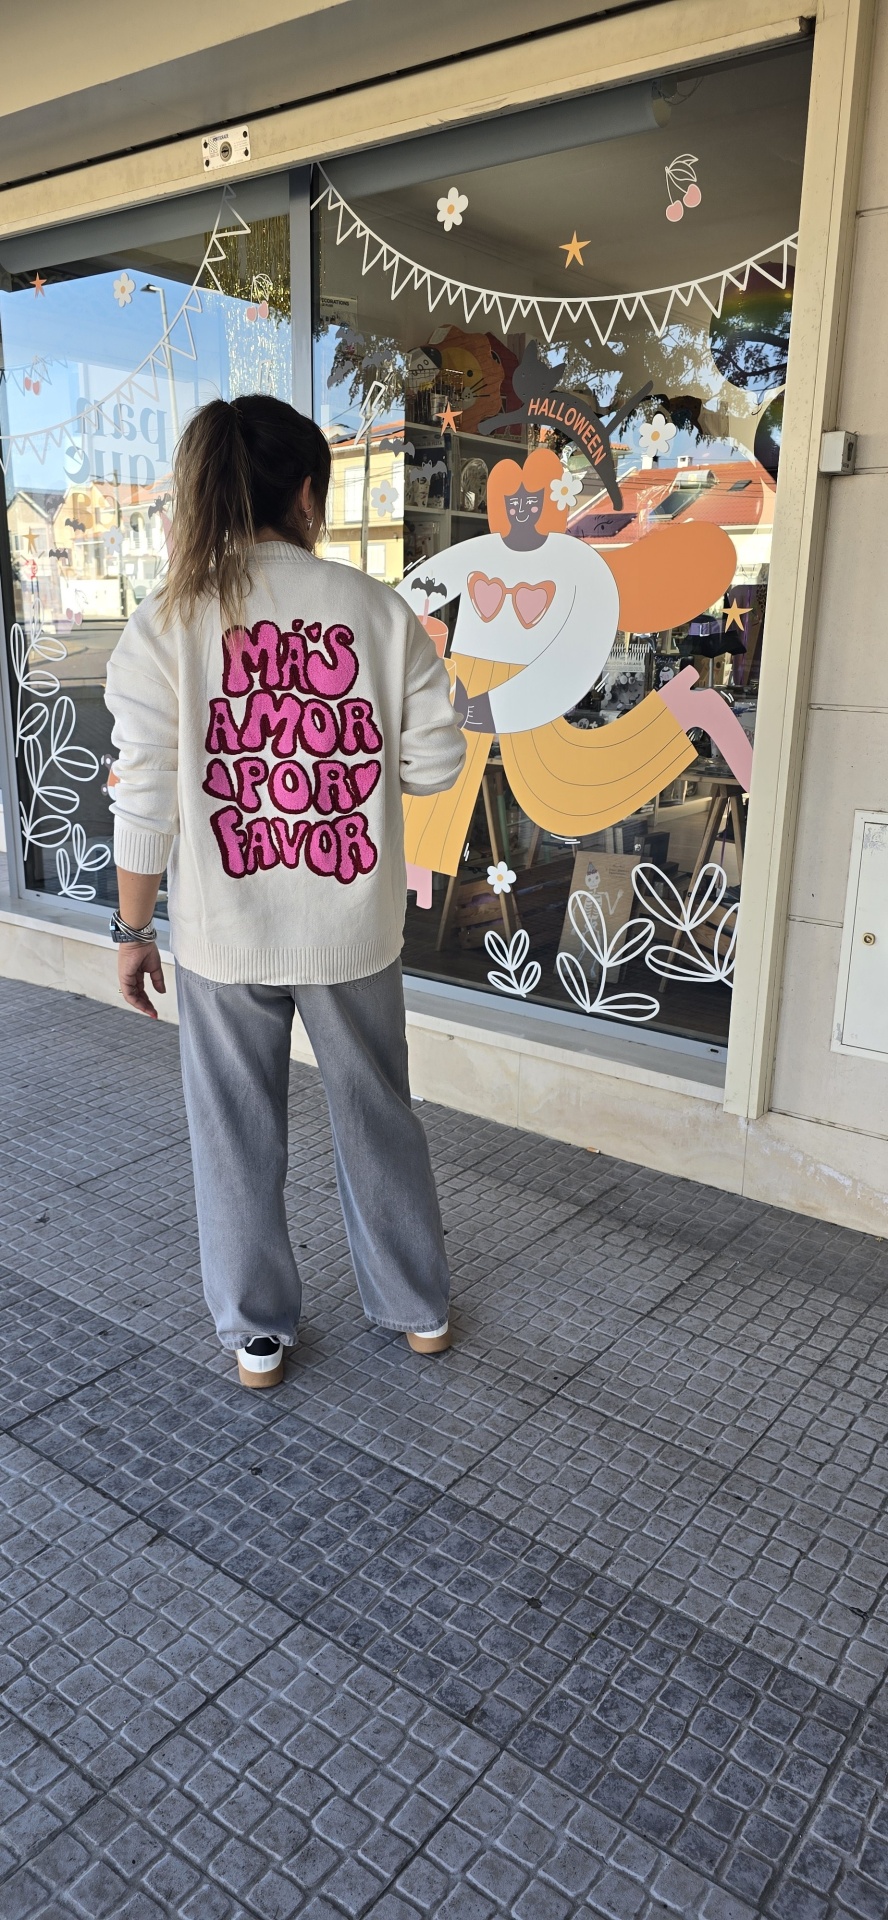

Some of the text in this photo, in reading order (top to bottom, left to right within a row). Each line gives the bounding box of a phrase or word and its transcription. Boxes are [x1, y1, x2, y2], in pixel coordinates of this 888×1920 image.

[528, 398, 607, 466] HALLOWEEN
[205, 689, 382, 757] AMOR
[233, 757, 357, 815] POR
[210, 805, 378, 884] FAVOR
